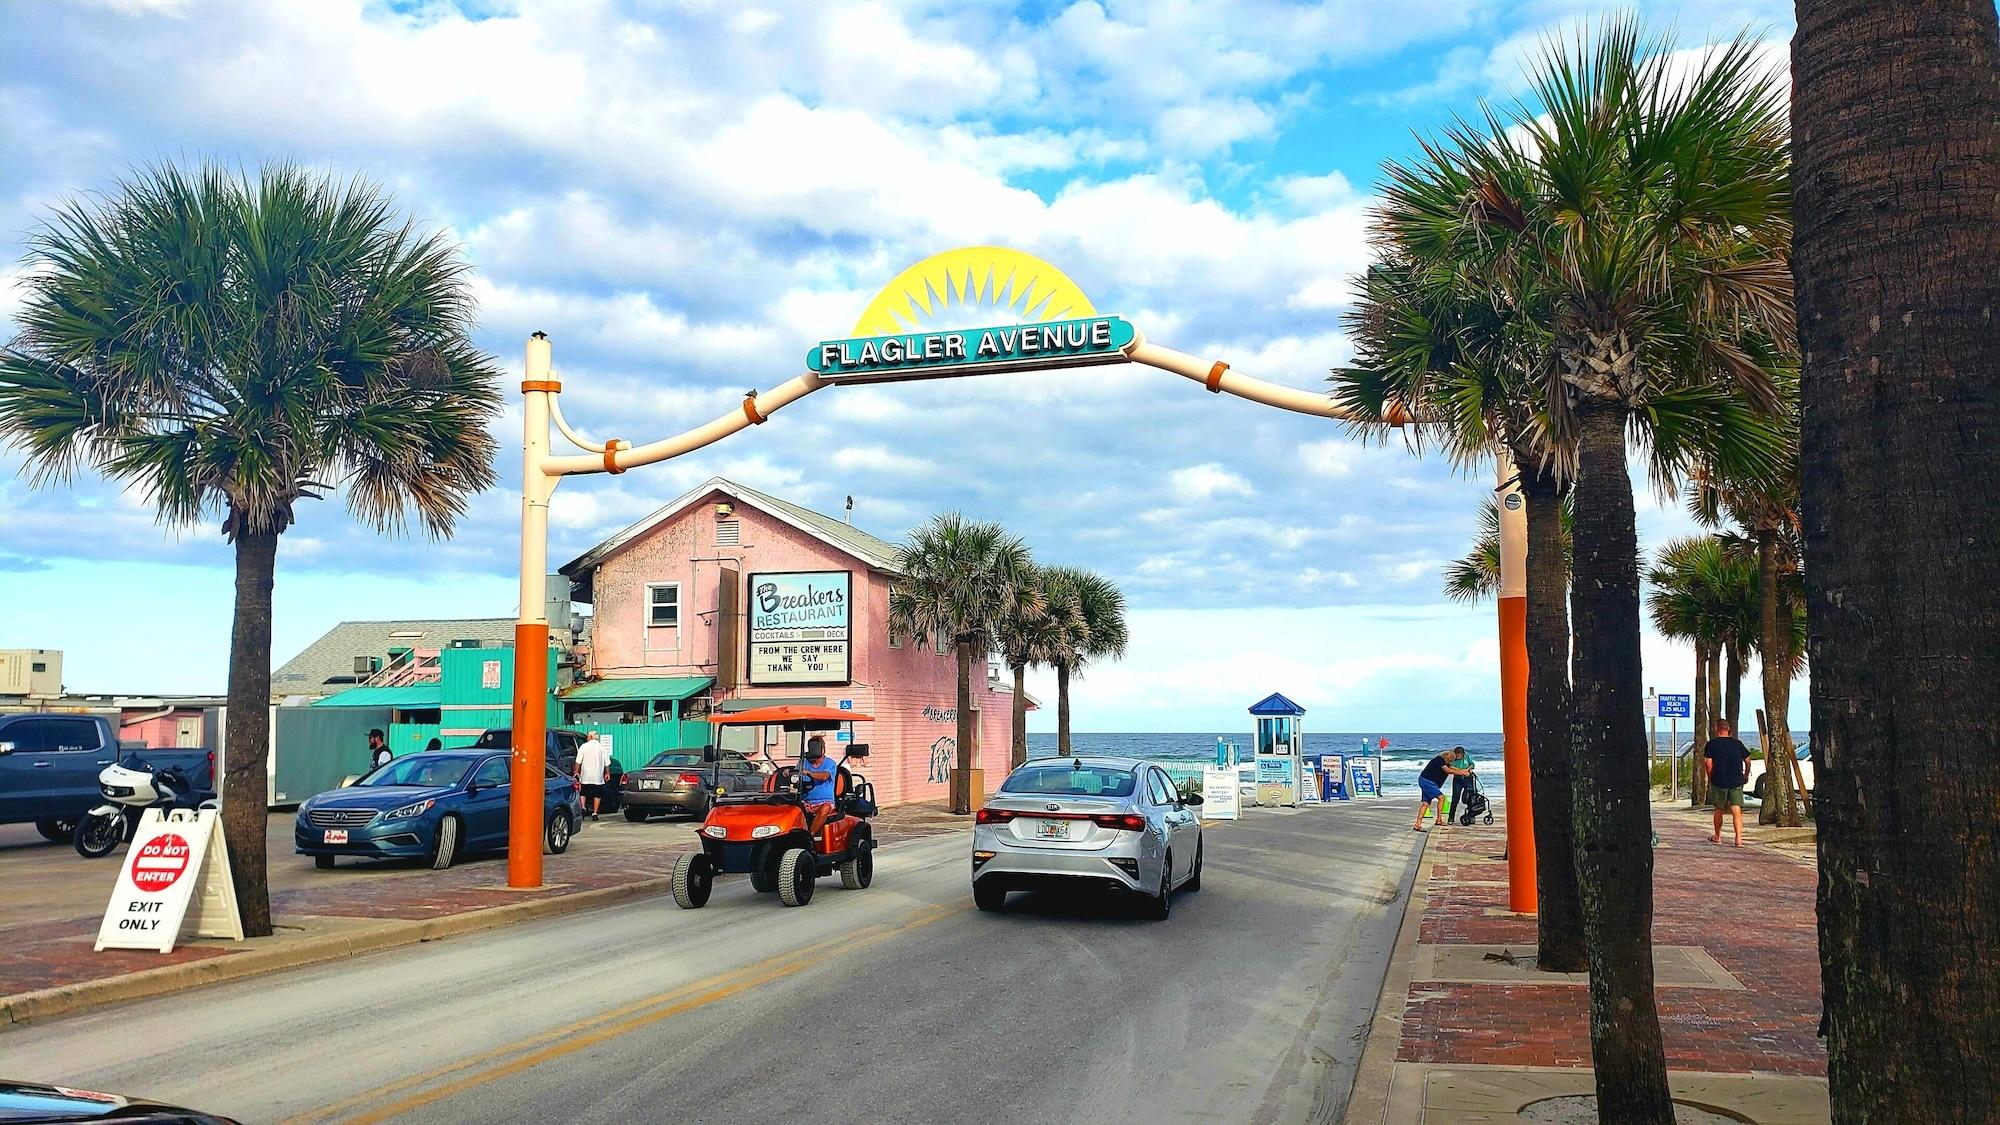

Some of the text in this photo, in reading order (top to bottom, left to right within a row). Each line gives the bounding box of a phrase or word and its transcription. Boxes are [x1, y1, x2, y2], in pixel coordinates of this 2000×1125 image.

[821, 320, 1112, 367] FLAGLER AVENUE
[758, 584, 774, 594] The
[757, 582, 844, 613] Breakers
[756, 604, 845, 628] RESTAURANT
[754, 631, 795, 640] COCKTAILS
[826, 630, 845, 638] DECK
[758, 645, 843, 655] FROM THE CREW HERE
[782, 654, 818, 663] WE SAY
[767, 663, 793, 672] THANK
[143, 845, 188, 857] DO NOT
[136, 871, 175, 882] ENTER
[127, 901, 164, 913] EXIT
[118, 918, 161, 931] ONLY
